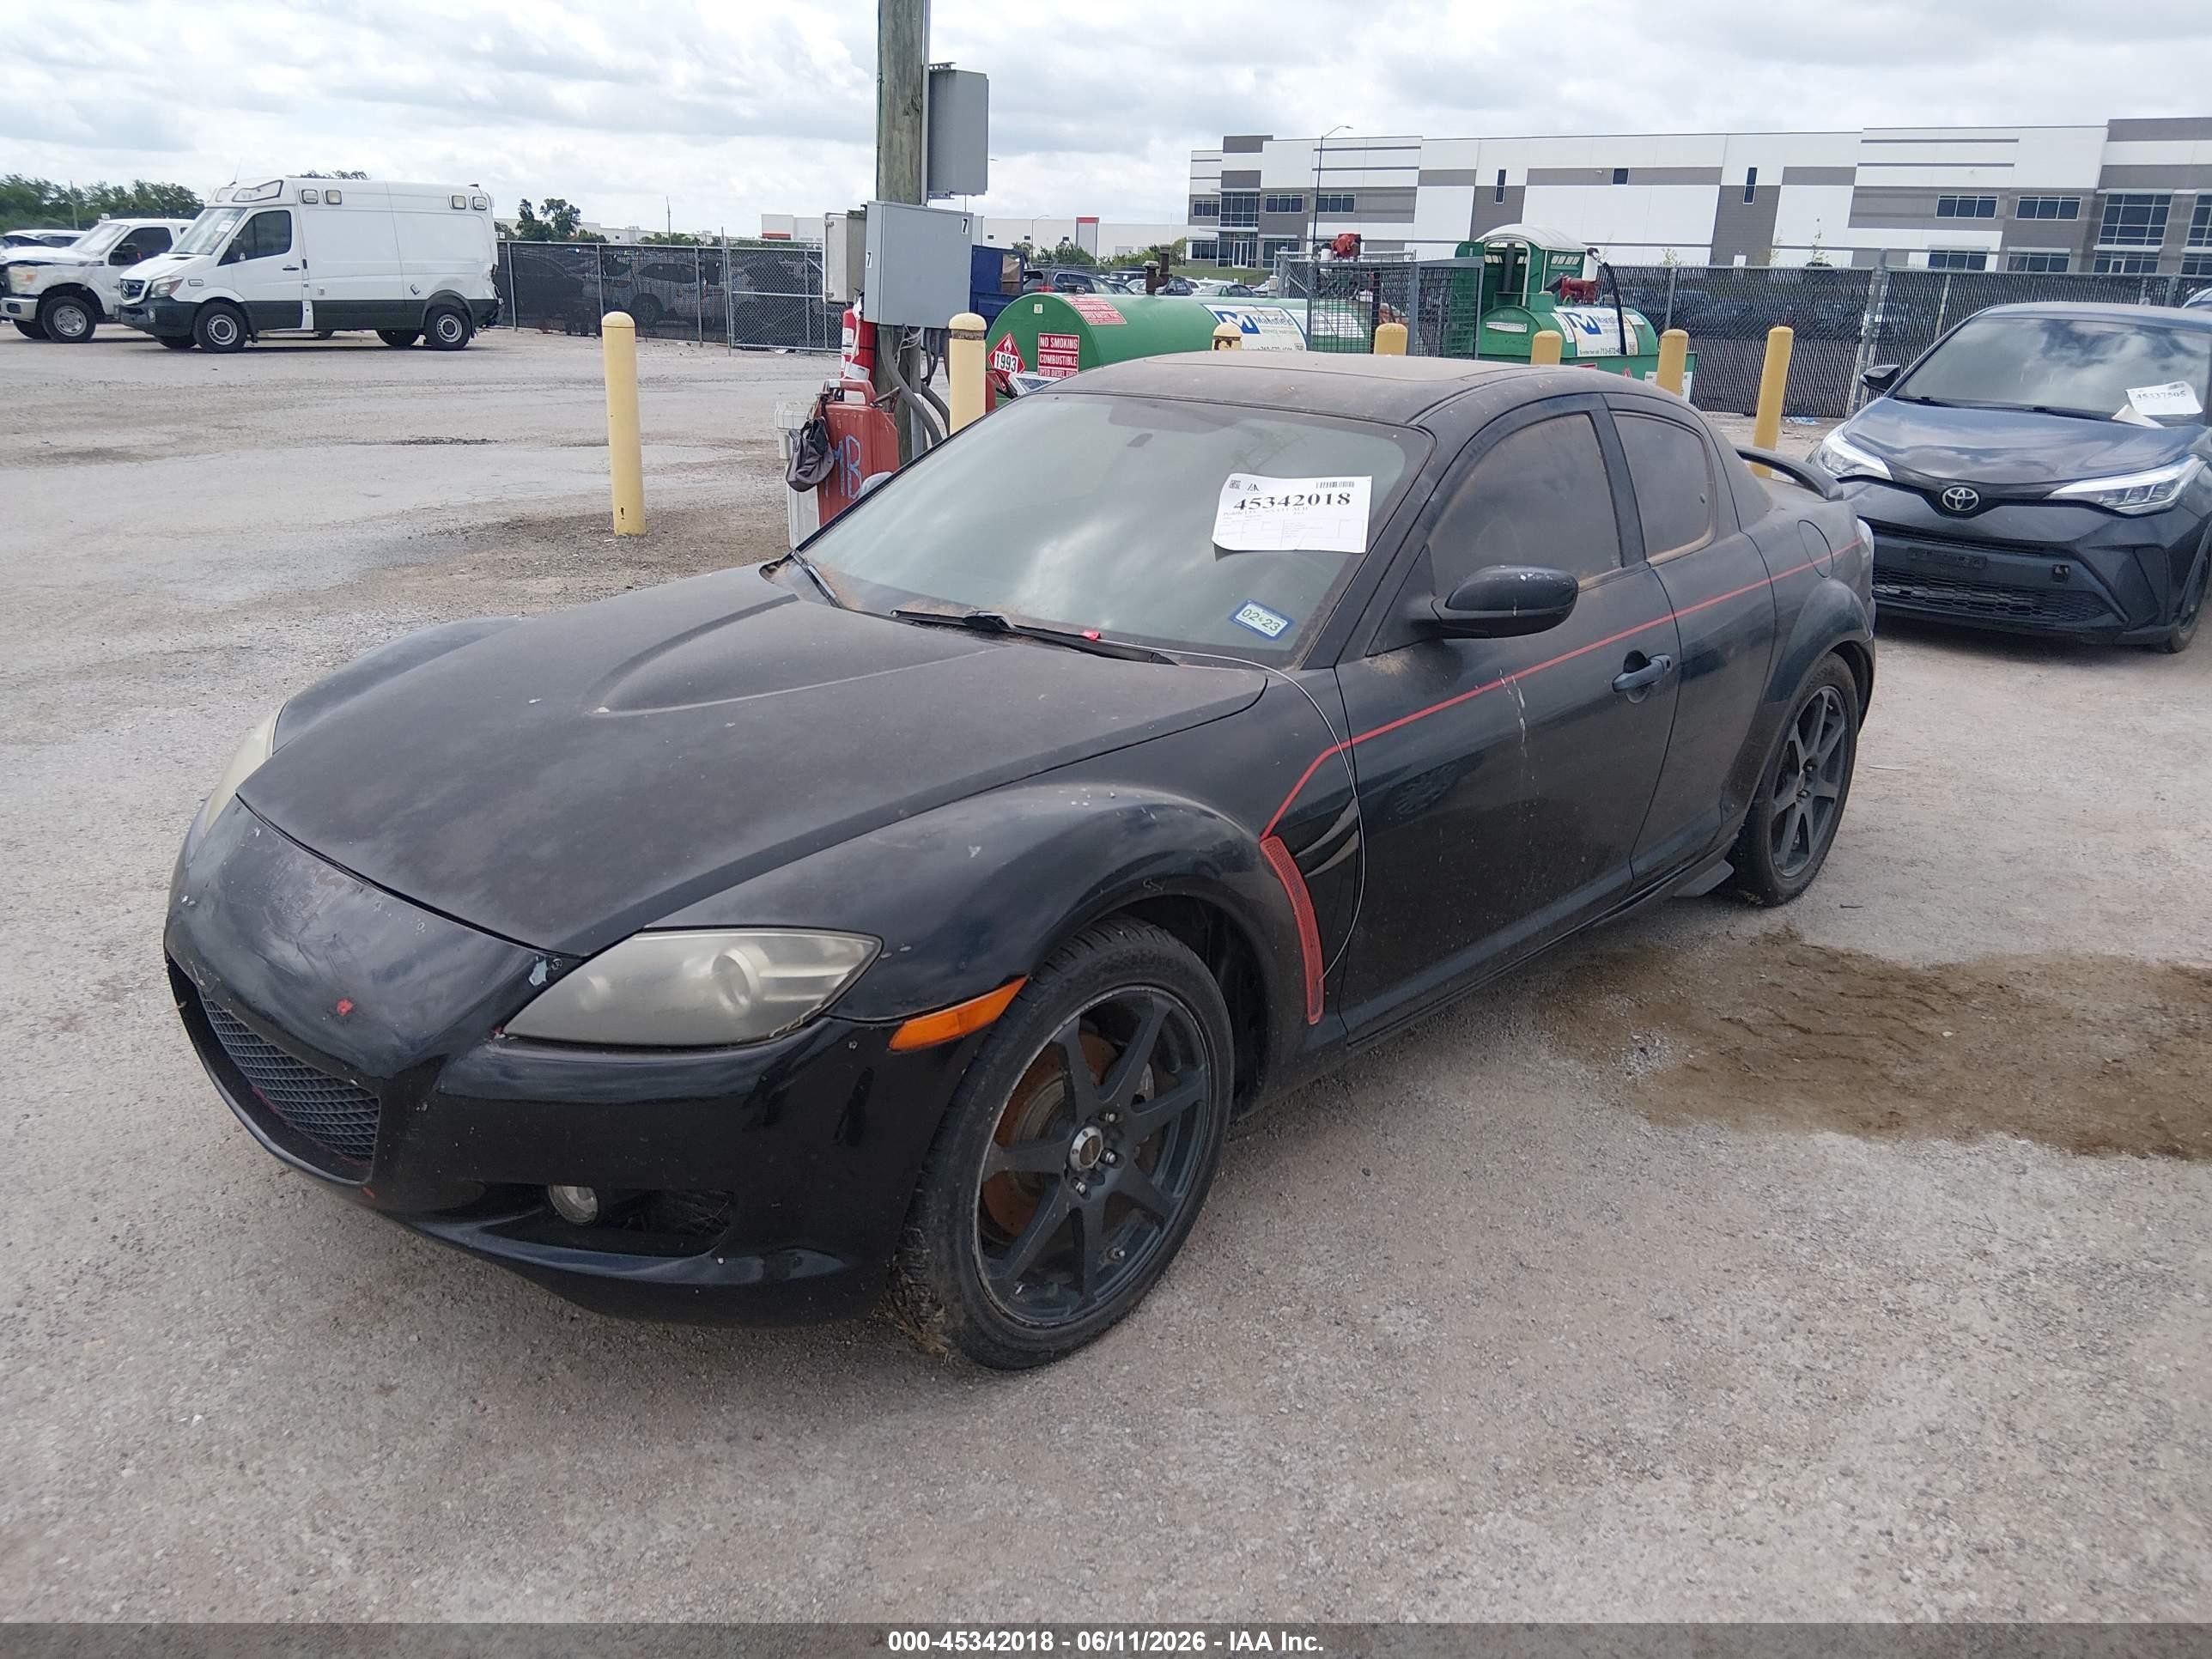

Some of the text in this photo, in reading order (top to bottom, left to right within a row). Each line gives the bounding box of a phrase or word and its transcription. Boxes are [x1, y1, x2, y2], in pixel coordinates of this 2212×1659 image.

[963, 218, 968, 234] 7
[866, 252, 872, 267] 7
[1040, 336, 1079, 349] NO SMOKING
[996, 354, 1017, 373] 1993
[1039, 354, 1078, 366] COMBUSTIBLE
[1233, 492, 1352, 511] 45342018
[1261, 618, 1281, 632] 23
